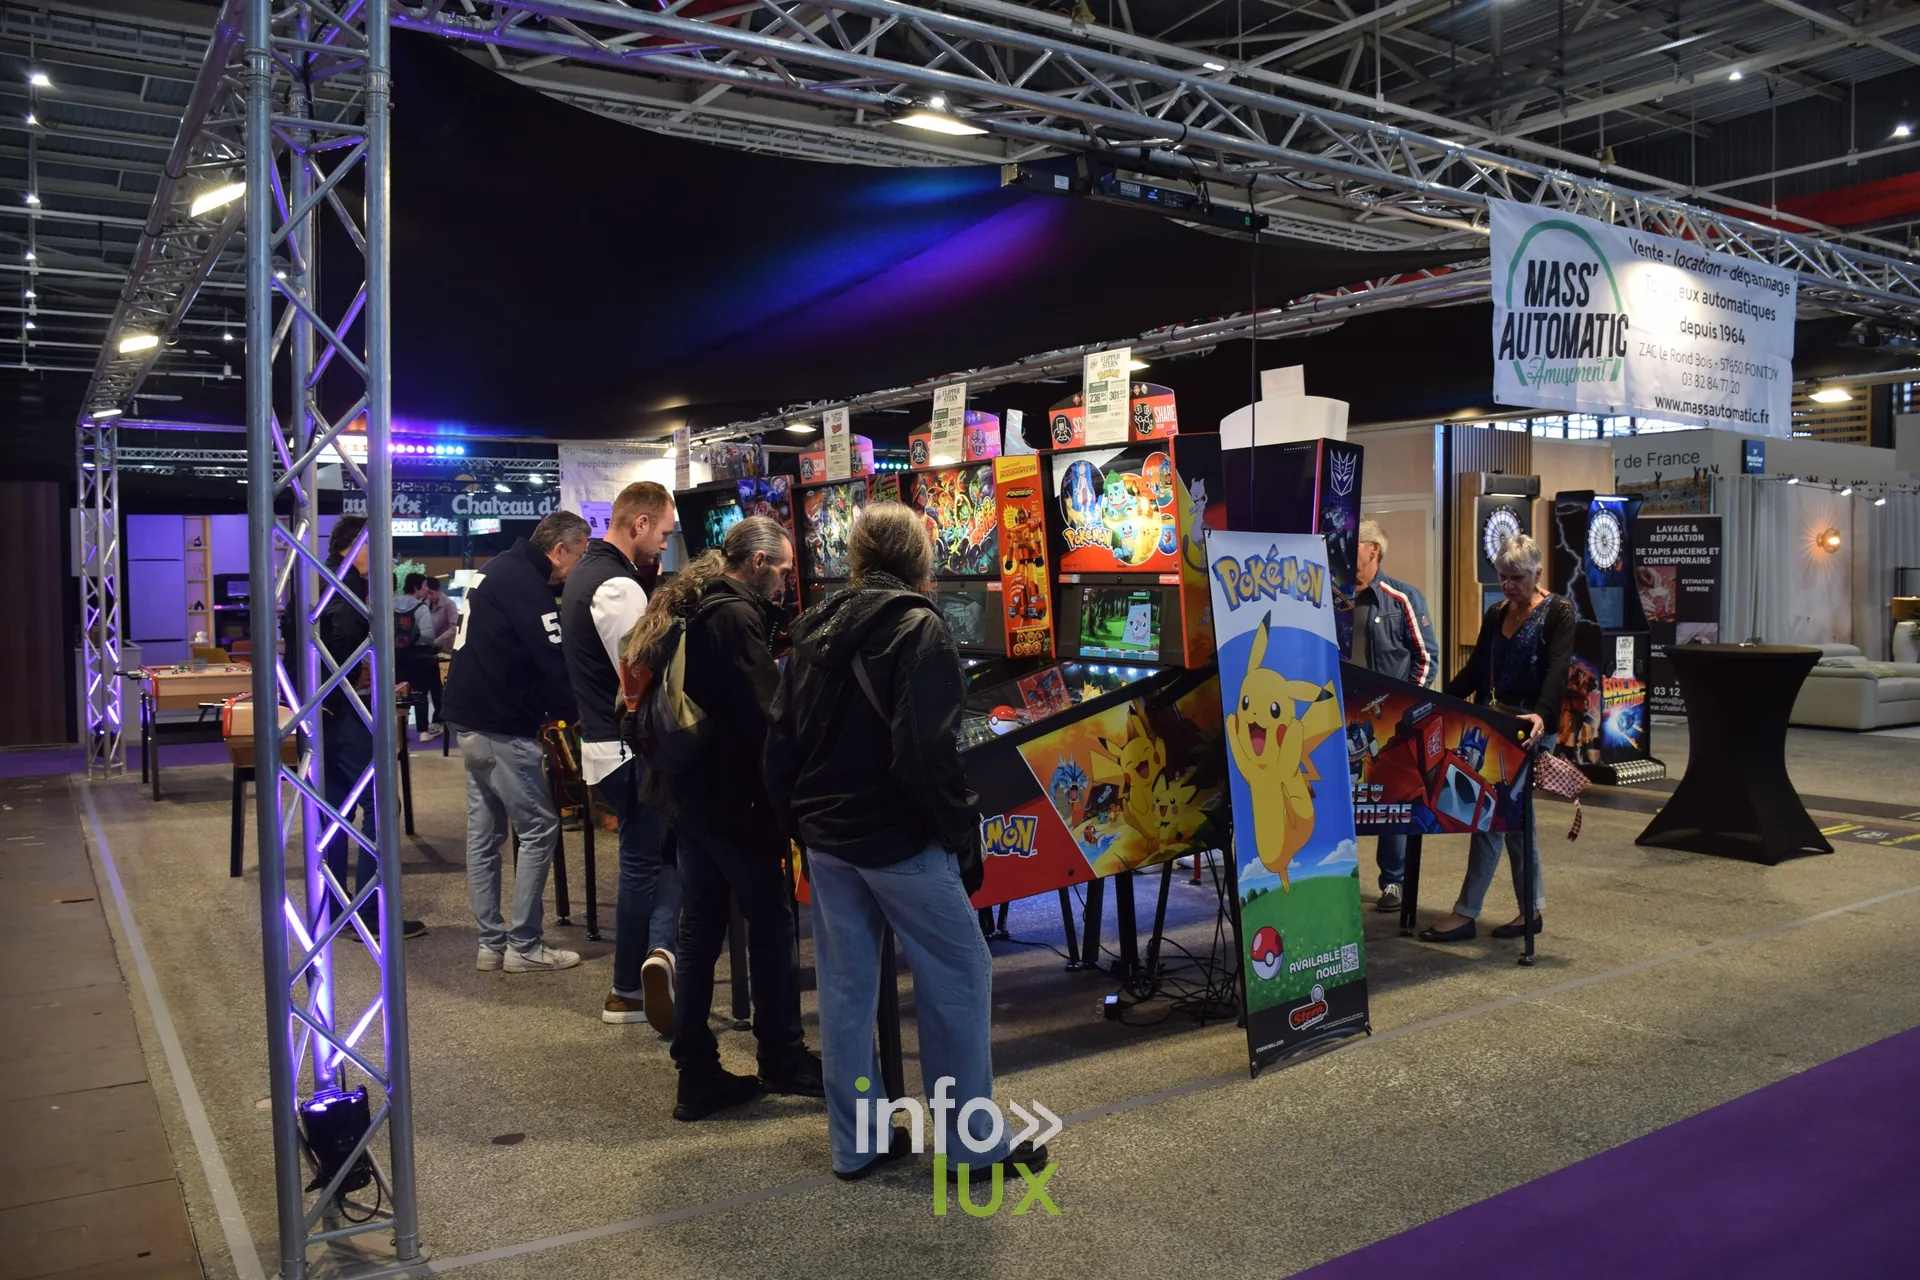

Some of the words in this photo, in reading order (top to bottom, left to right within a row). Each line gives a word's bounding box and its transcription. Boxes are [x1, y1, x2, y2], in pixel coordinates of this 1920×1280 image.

[1629, 237, 1663, 262] Vente
[1674, 249, 1721, 277] location
[1729, 265, 1790, 297] dépannage
[1524, 260, 1598, 307] MASS'
[1702, 291, 1776, 321] automatiques
[1498, 312, 1629, 360] AUTOMATIC
[1680, 316, 1717, 340] depuis
[1719, 324, 1745, 345] 1964
[1639, 342, 1656, 359] ZAC
[1660, 345, 1668, 361] Le
[1671, 348, 1693, 365] Rond
[1720, 358, 1743, 374] 57650
[1527, 355, 1613, 390] Amusement
[1682, 372, 1692, 386] 03
[1695, 374, 1705, 389] 82
[1708, 376, 1718, 390] 84
[1720, 378, 1729, 392] 77
[1731, 381, 1740, 394] 20
[1655, 396, 1769, 424] www.massautomatic.fr
[1624, 454, 1642, 468] de
[1647, 451, 1700, 467] France
[452, 494, 534, 515] Chateau
[1650, 534, 1704, 542] REPARATION
[1656, 525, 1689, 533] LAVAGE
[1672, 547, 1707, 555] ANCIENS
[1709, 547, 1719, 555] ET
[1654, 687, 1666, 696] 03
[1669, 687, 1681, 696] 12
[1289, 949, 1341, 974] AVAILABLE
[1316, 963, 1342, 980] NOW!
